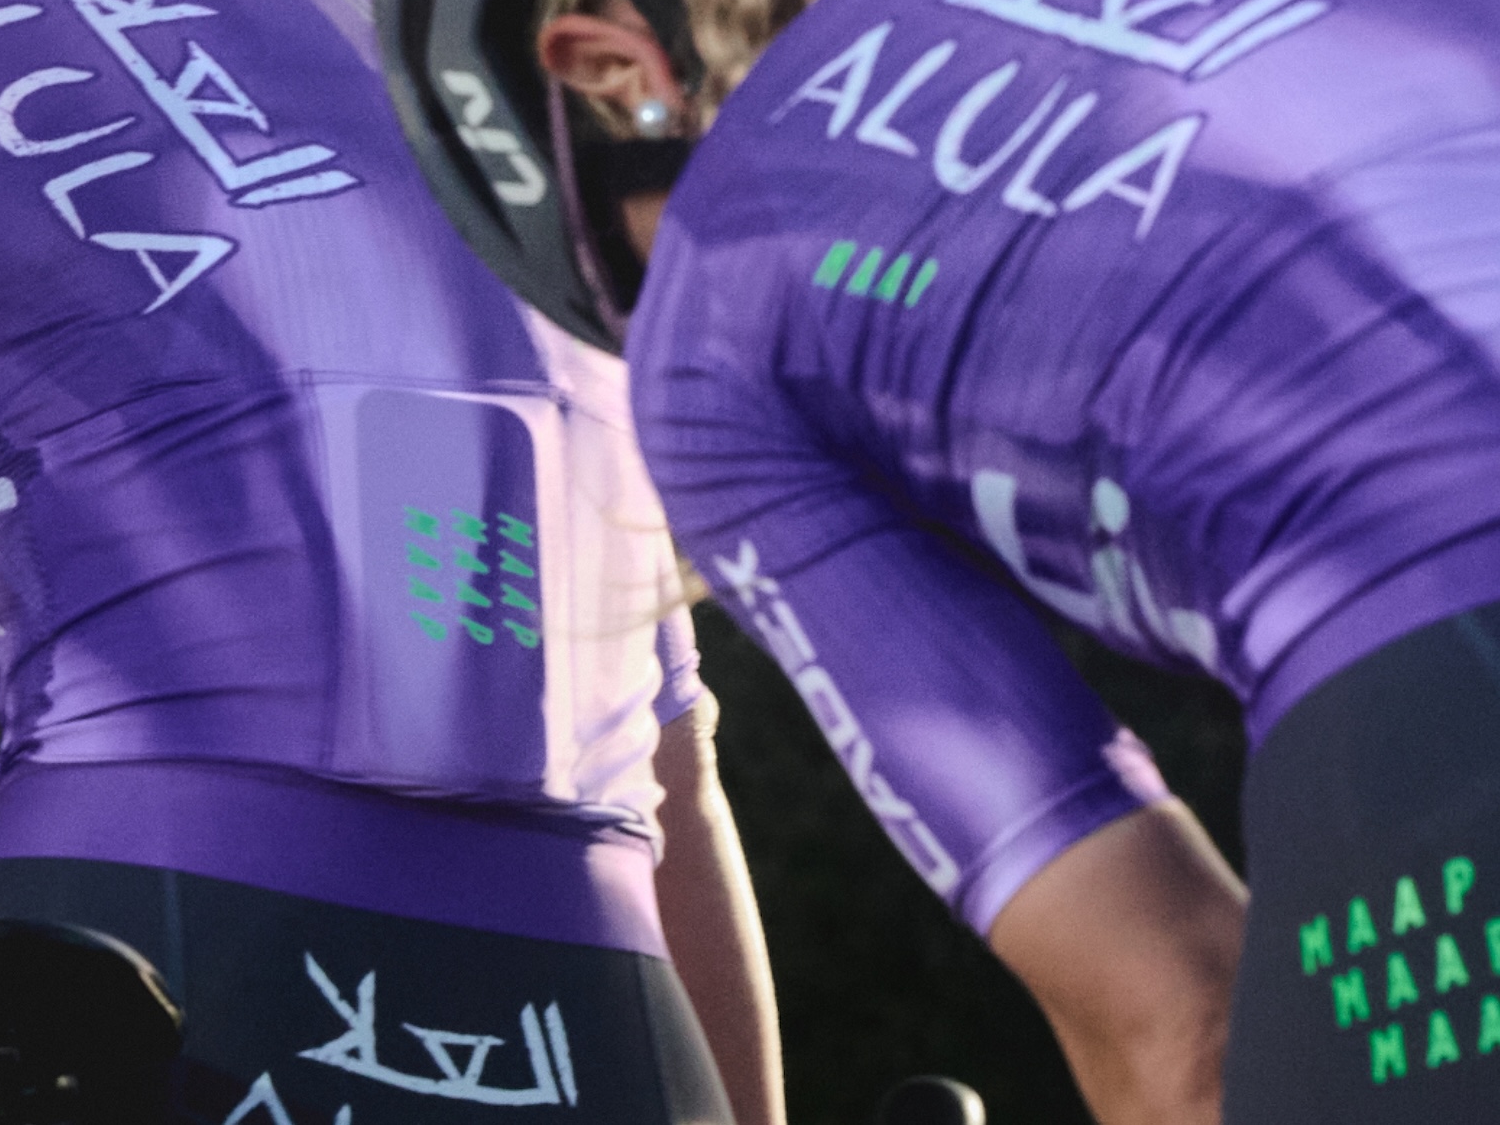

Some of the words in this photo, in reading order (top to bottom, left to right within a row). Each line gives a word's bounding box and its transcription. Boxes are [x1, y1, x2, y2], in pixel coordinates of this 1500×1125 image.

[768, 20, 1204, 242] ALULA
[403, 505, 449, 642] MAAP
[451, 507, 496, 646] MAAP
[497, 511, 540, 650] MAAP
[1299, 855, 1477, 976] MAAP
[1367, 993, 1500, 1086] MAA
